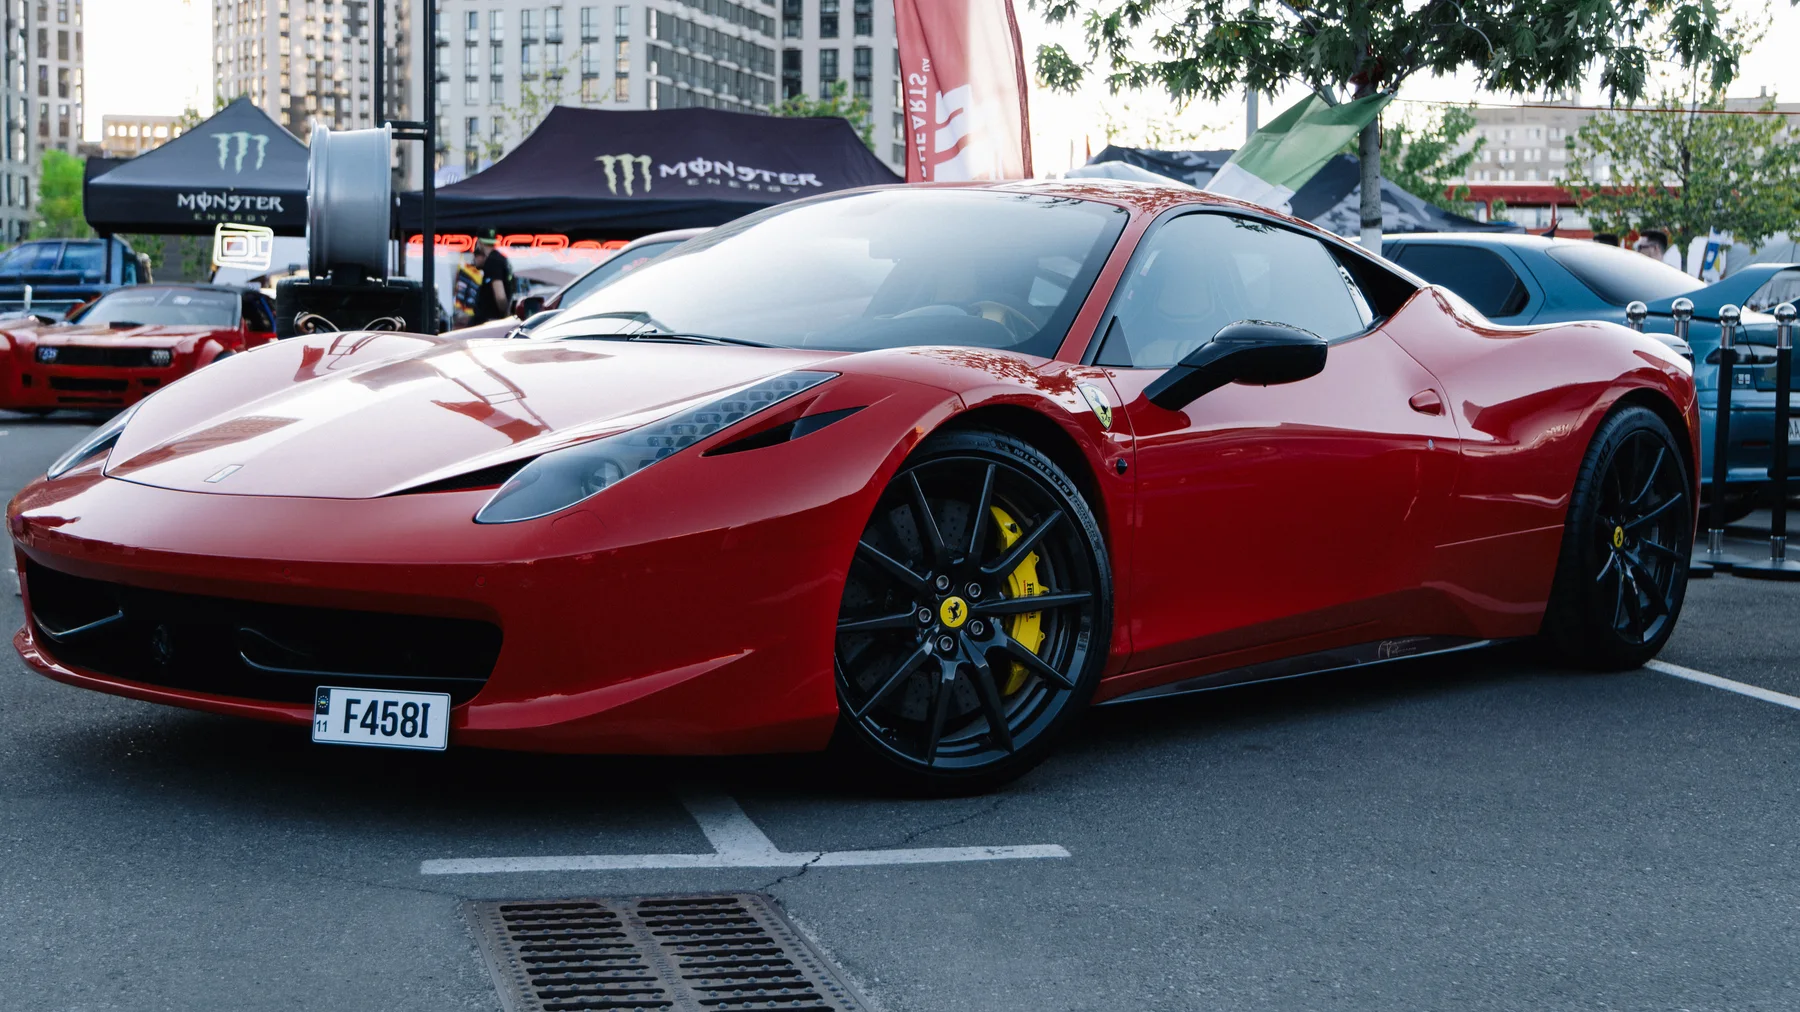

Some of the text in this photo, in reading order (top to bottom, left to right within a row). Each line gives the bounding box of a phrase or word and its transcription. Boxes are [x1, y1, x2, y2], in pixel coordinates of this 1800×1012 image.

[658, 157, 823, 187] MONSTER
[687, 177, 801, 194] ENERGY
[177, 191, 284, 213] MONSTER
[193, 212, 269, 223] ENERGY
[1013, 448, 1070, 494] MICHELIN
[316, 719, 328, 733] 11
